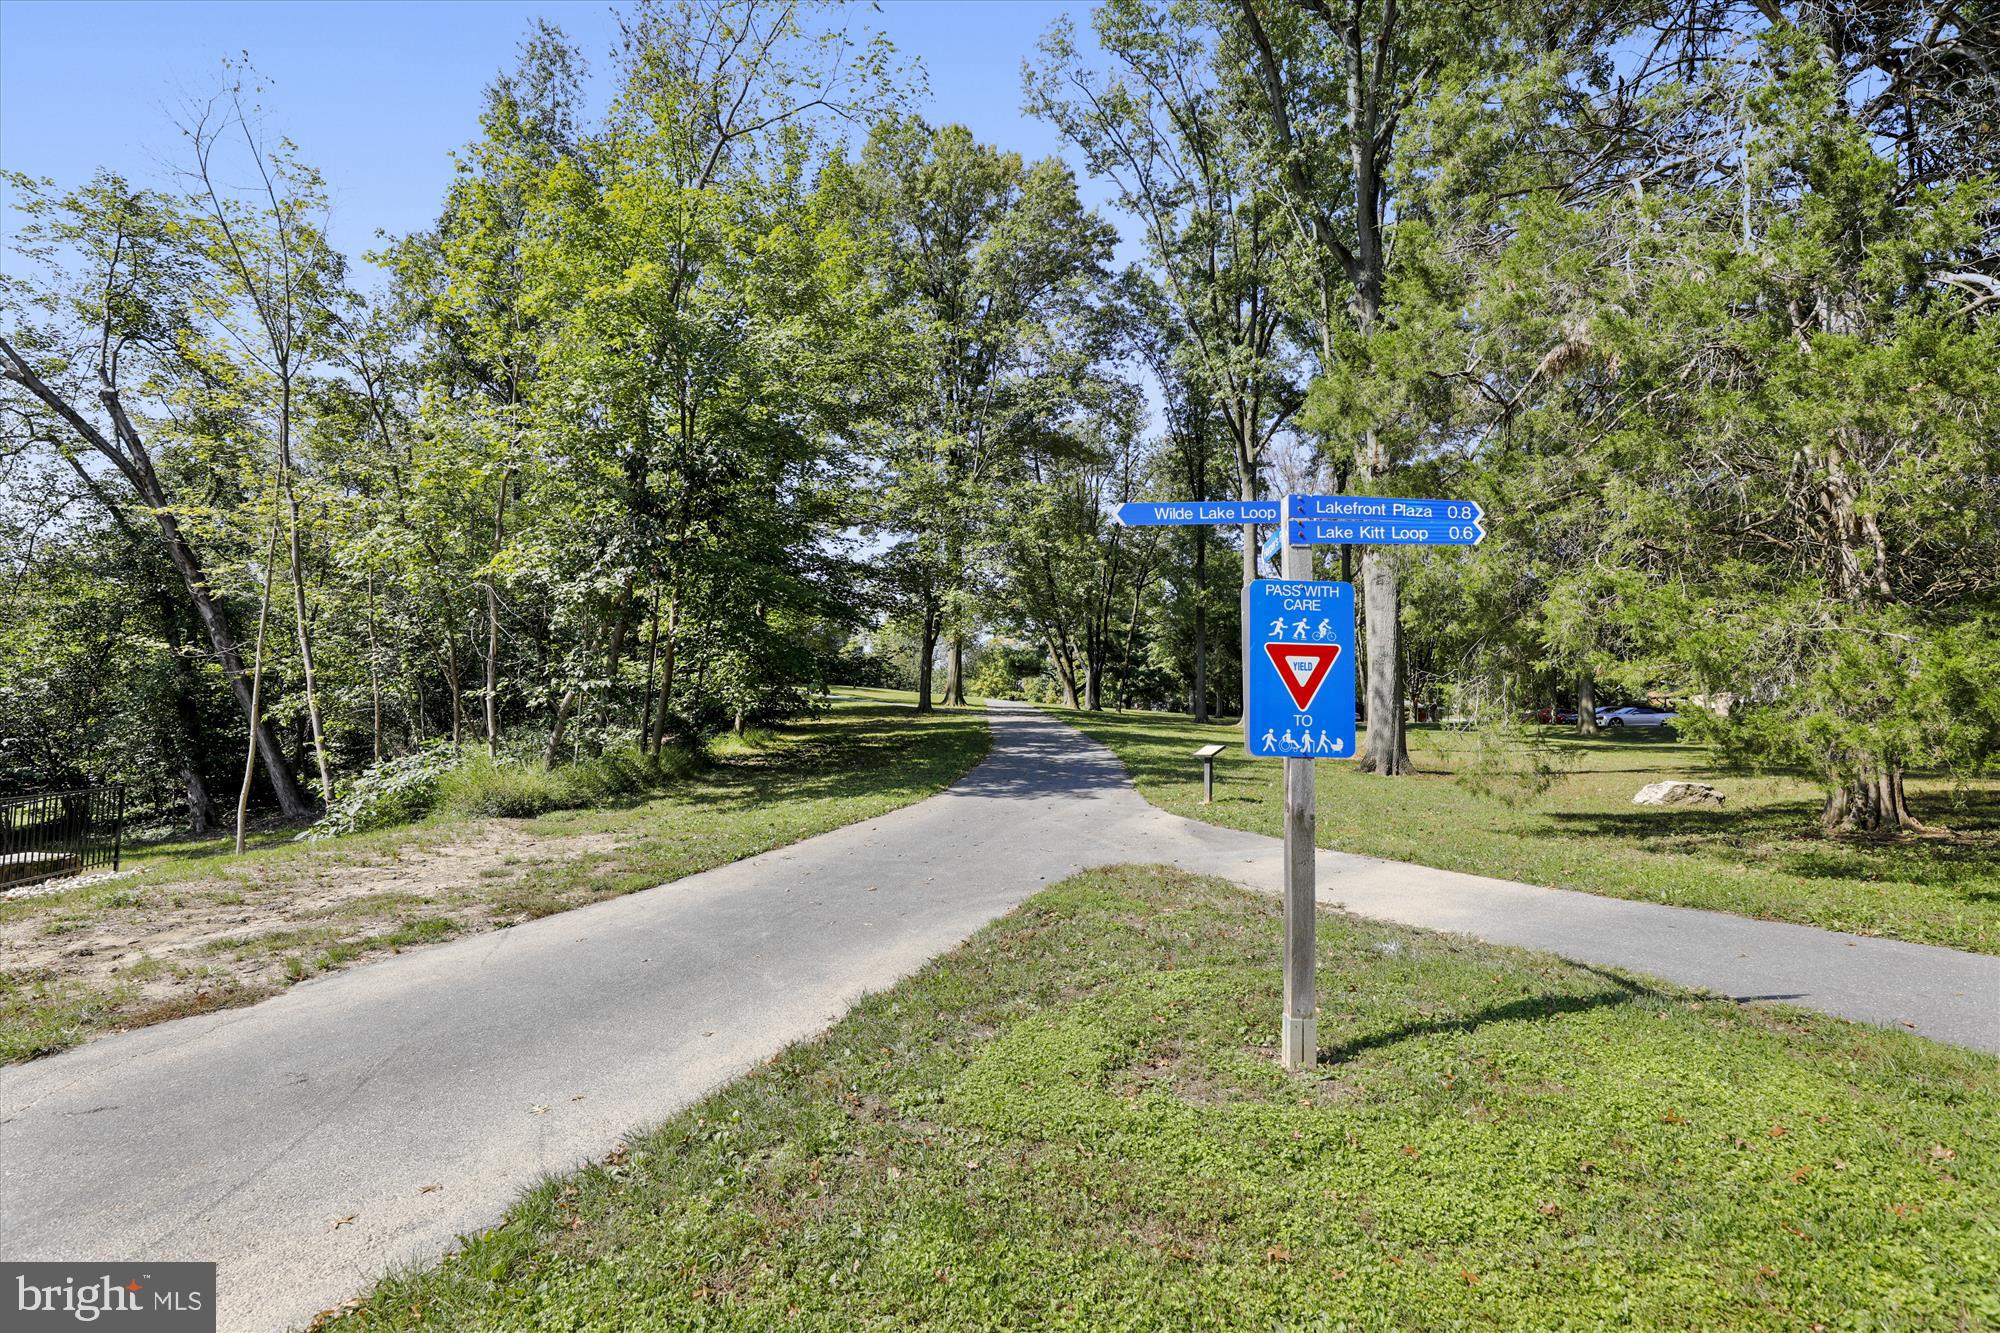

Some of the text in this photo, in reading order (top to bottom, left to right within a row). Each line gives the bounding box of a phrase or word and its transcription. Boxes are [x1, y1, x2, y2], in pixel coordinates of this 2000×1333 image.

[1154, 506, 1277, 521] Wilde Lake Loop
[1316, 500, 1472, 520] Lakefront Plaza 0.8
[1317, 525, 1473, 541] Lake Kitt Loop 0.6
[1266, 585, 1339, 597] PASS WITH
[1284, 599, 1321, 611] CARE
[1293, 661, 1313, 671] YIELD
[1293, 715, 1313, 727] TO
